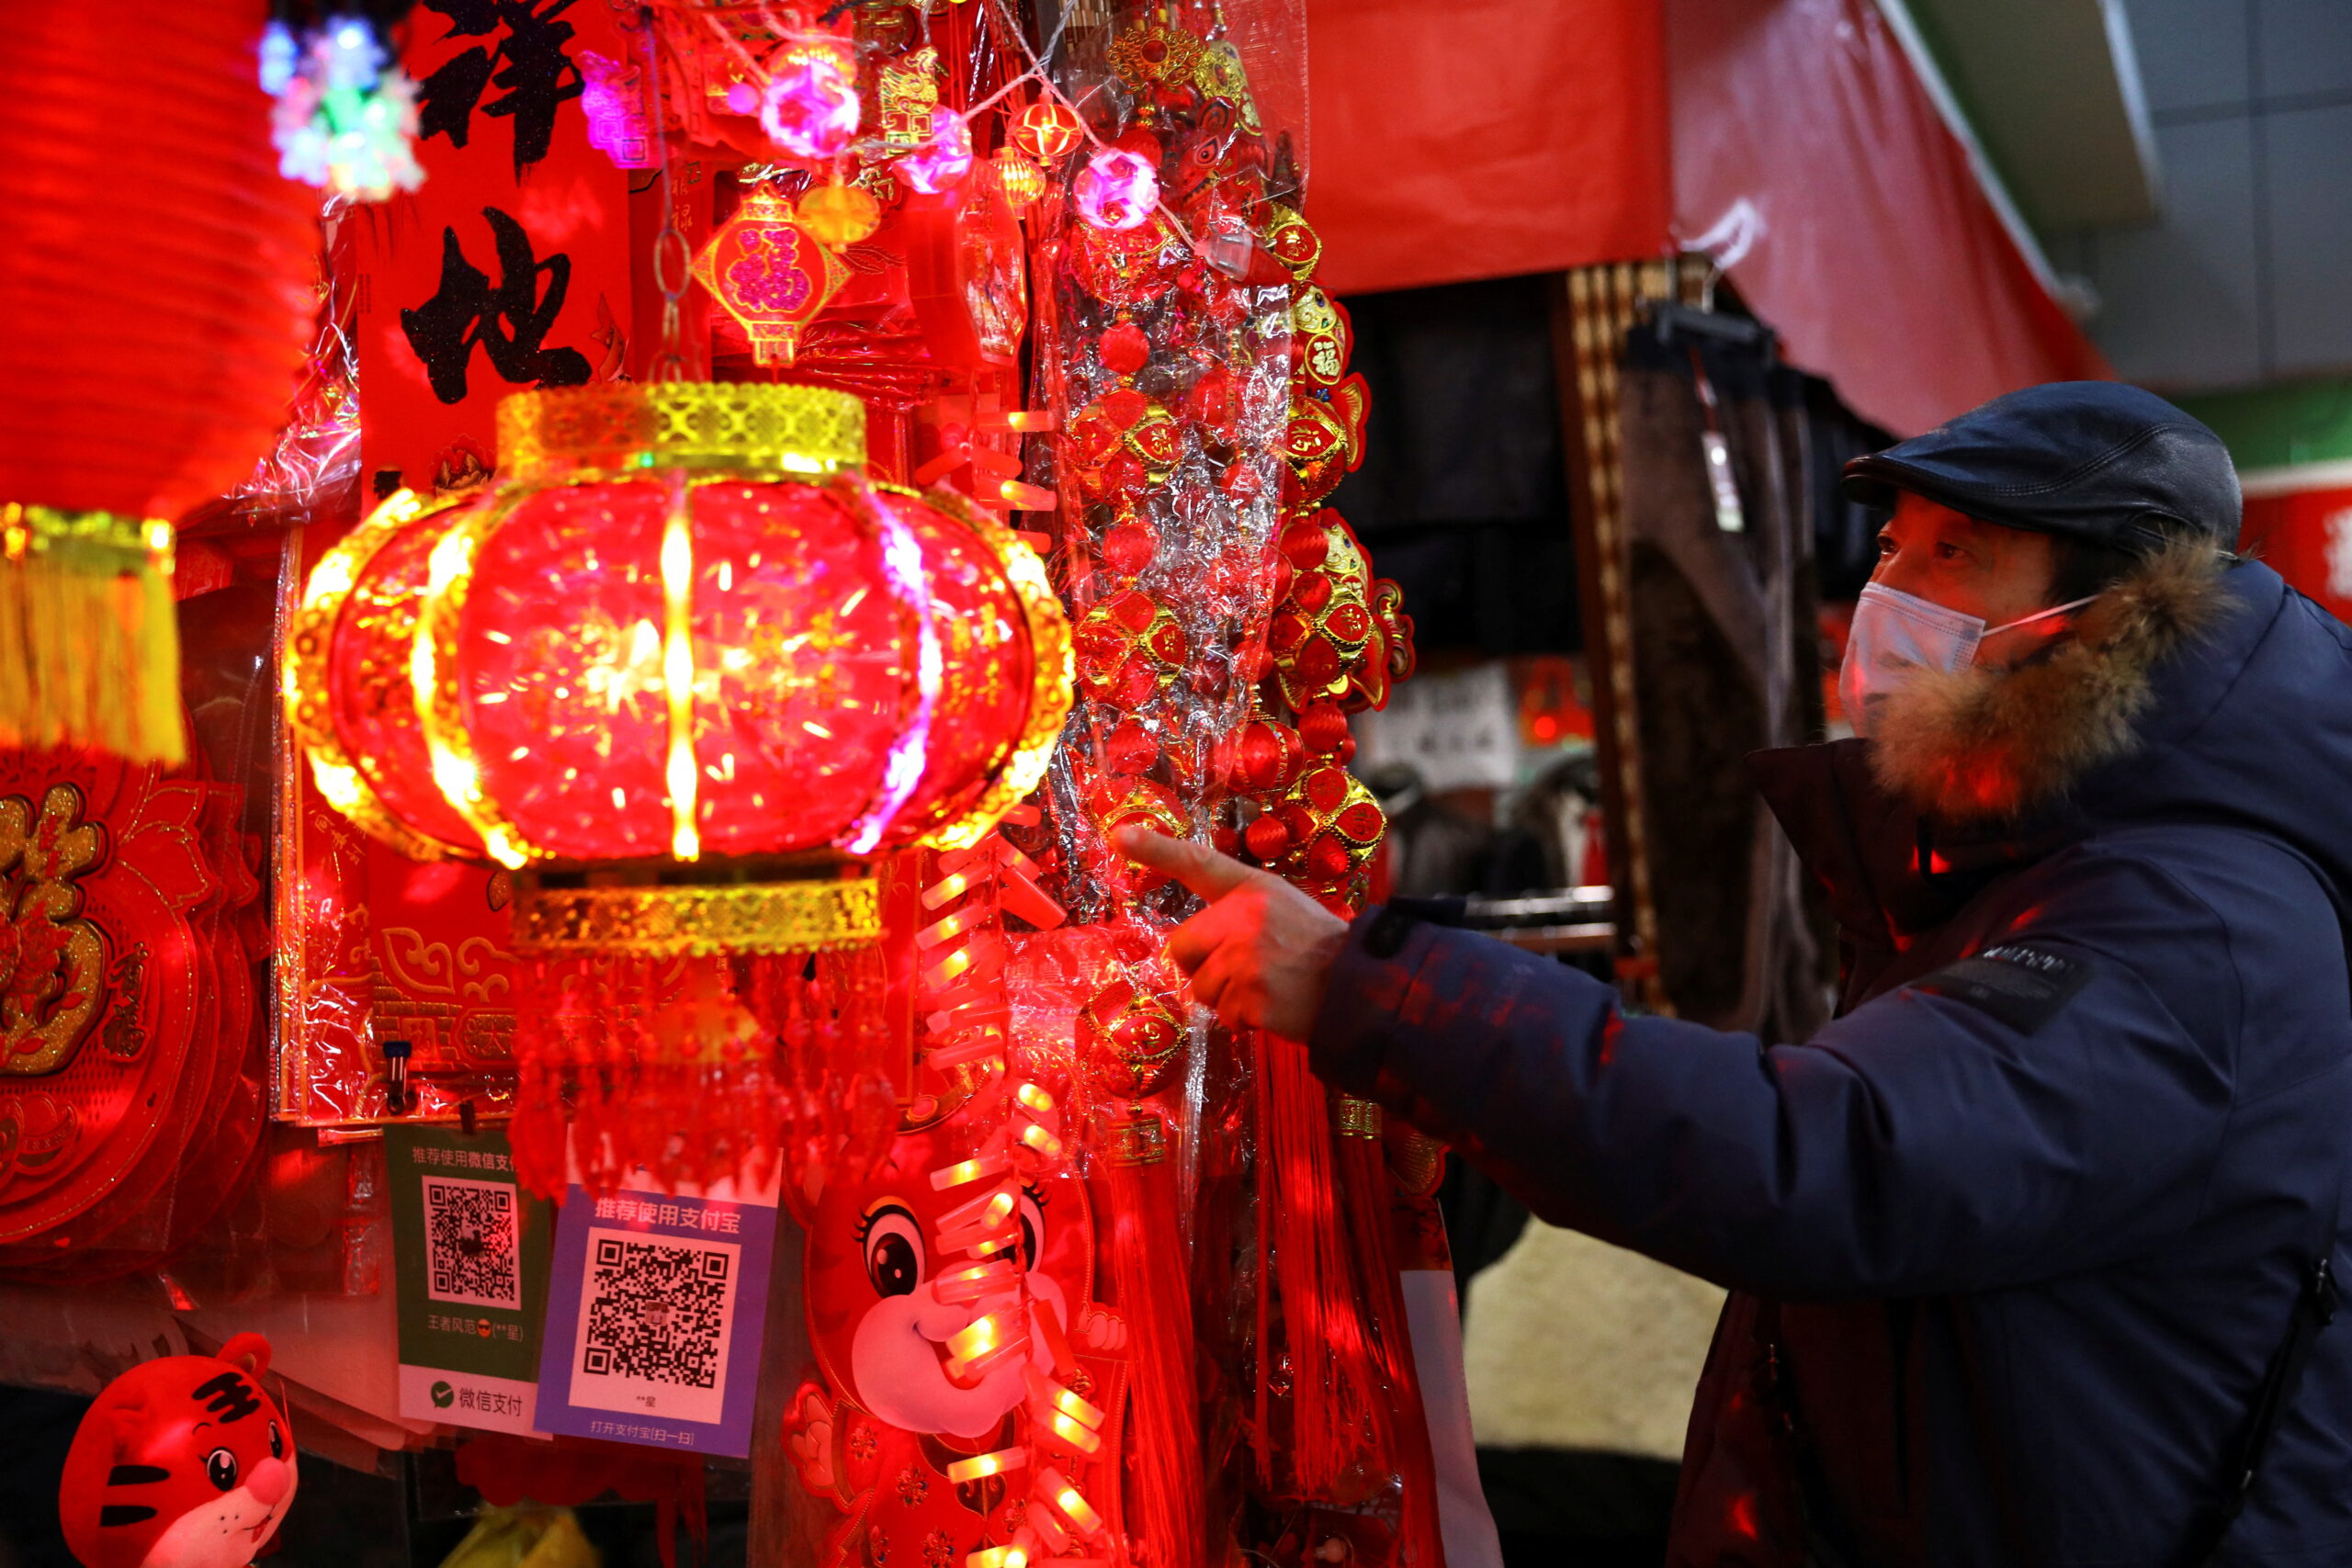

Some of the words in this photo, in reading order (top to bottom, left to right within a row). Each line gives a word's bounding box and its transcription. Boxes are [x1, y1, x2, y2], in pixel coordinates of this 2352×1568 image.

[726, 227, 812, 313] 福
[1312, 341, 1341, 376] 福
[594, 1197, 741, 1235] 推荐使用支付宝
[459, 1386, 523, 1416] 微信支付
